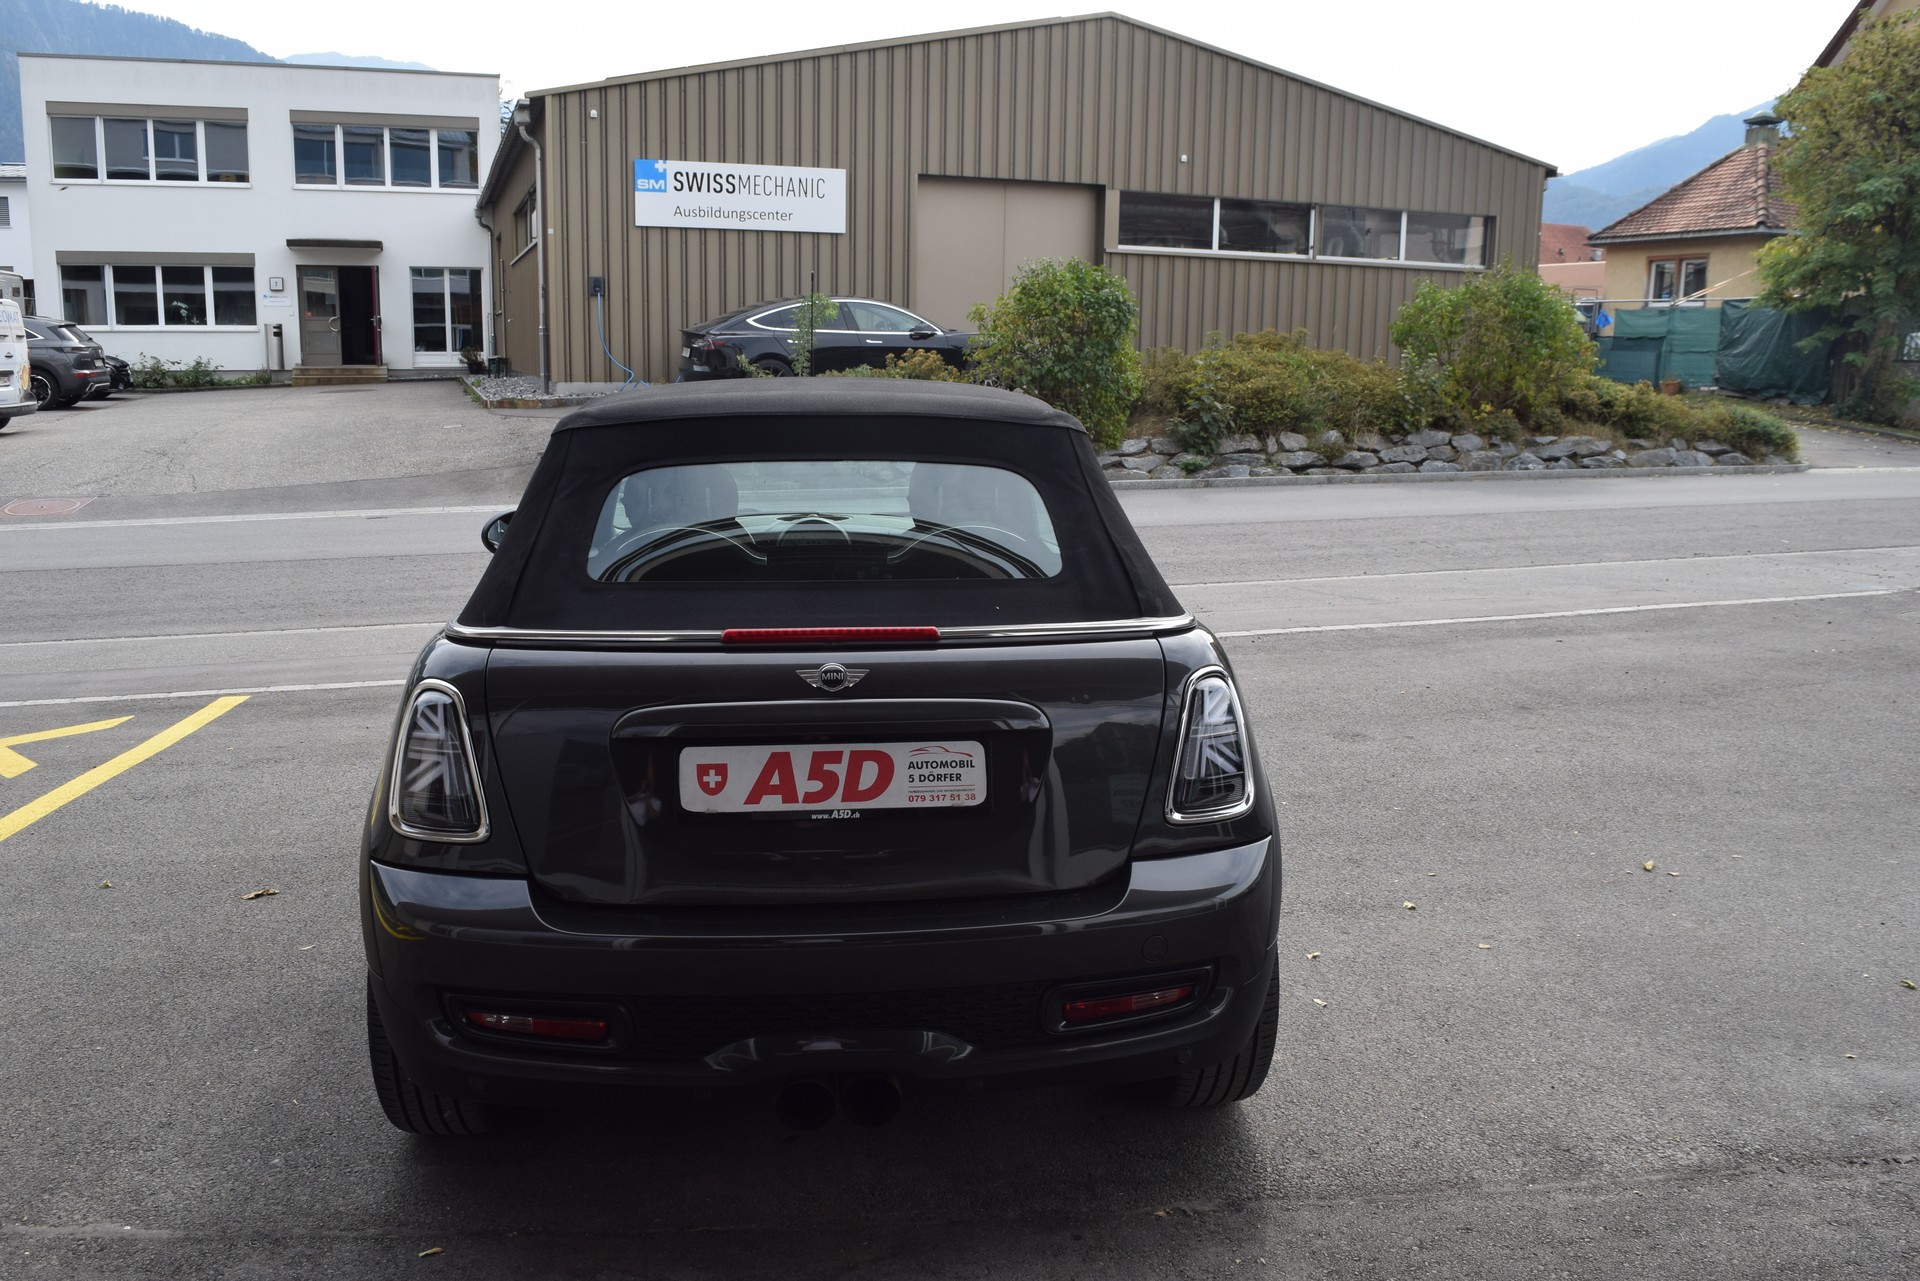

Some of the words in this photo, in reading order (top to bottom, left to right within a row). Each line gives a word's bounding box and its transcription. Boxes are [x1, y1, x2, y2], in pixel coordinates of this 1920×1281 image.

[637, 178, 665, 190] SM
[673, 171, 826, 199] SWISSMECHANIC
[673, 205, 794, 222] Ausbildungscenter
[821, 672, 844, 680] MINI
[908, 759, 975, 770] AUTOMOBIL
[743, 749, 895, 805] A5D
[908, 774, 915, 783] 5
[918, 771, 962, 783] DÖRFER
[908, 794, 926, 802] 079
[929, 794, 947, 802] 317
[950, 793, 961, 801] 51
[964, 793, 976, 801] 38
[811, 809, 860, 819] www.A5D.ch
